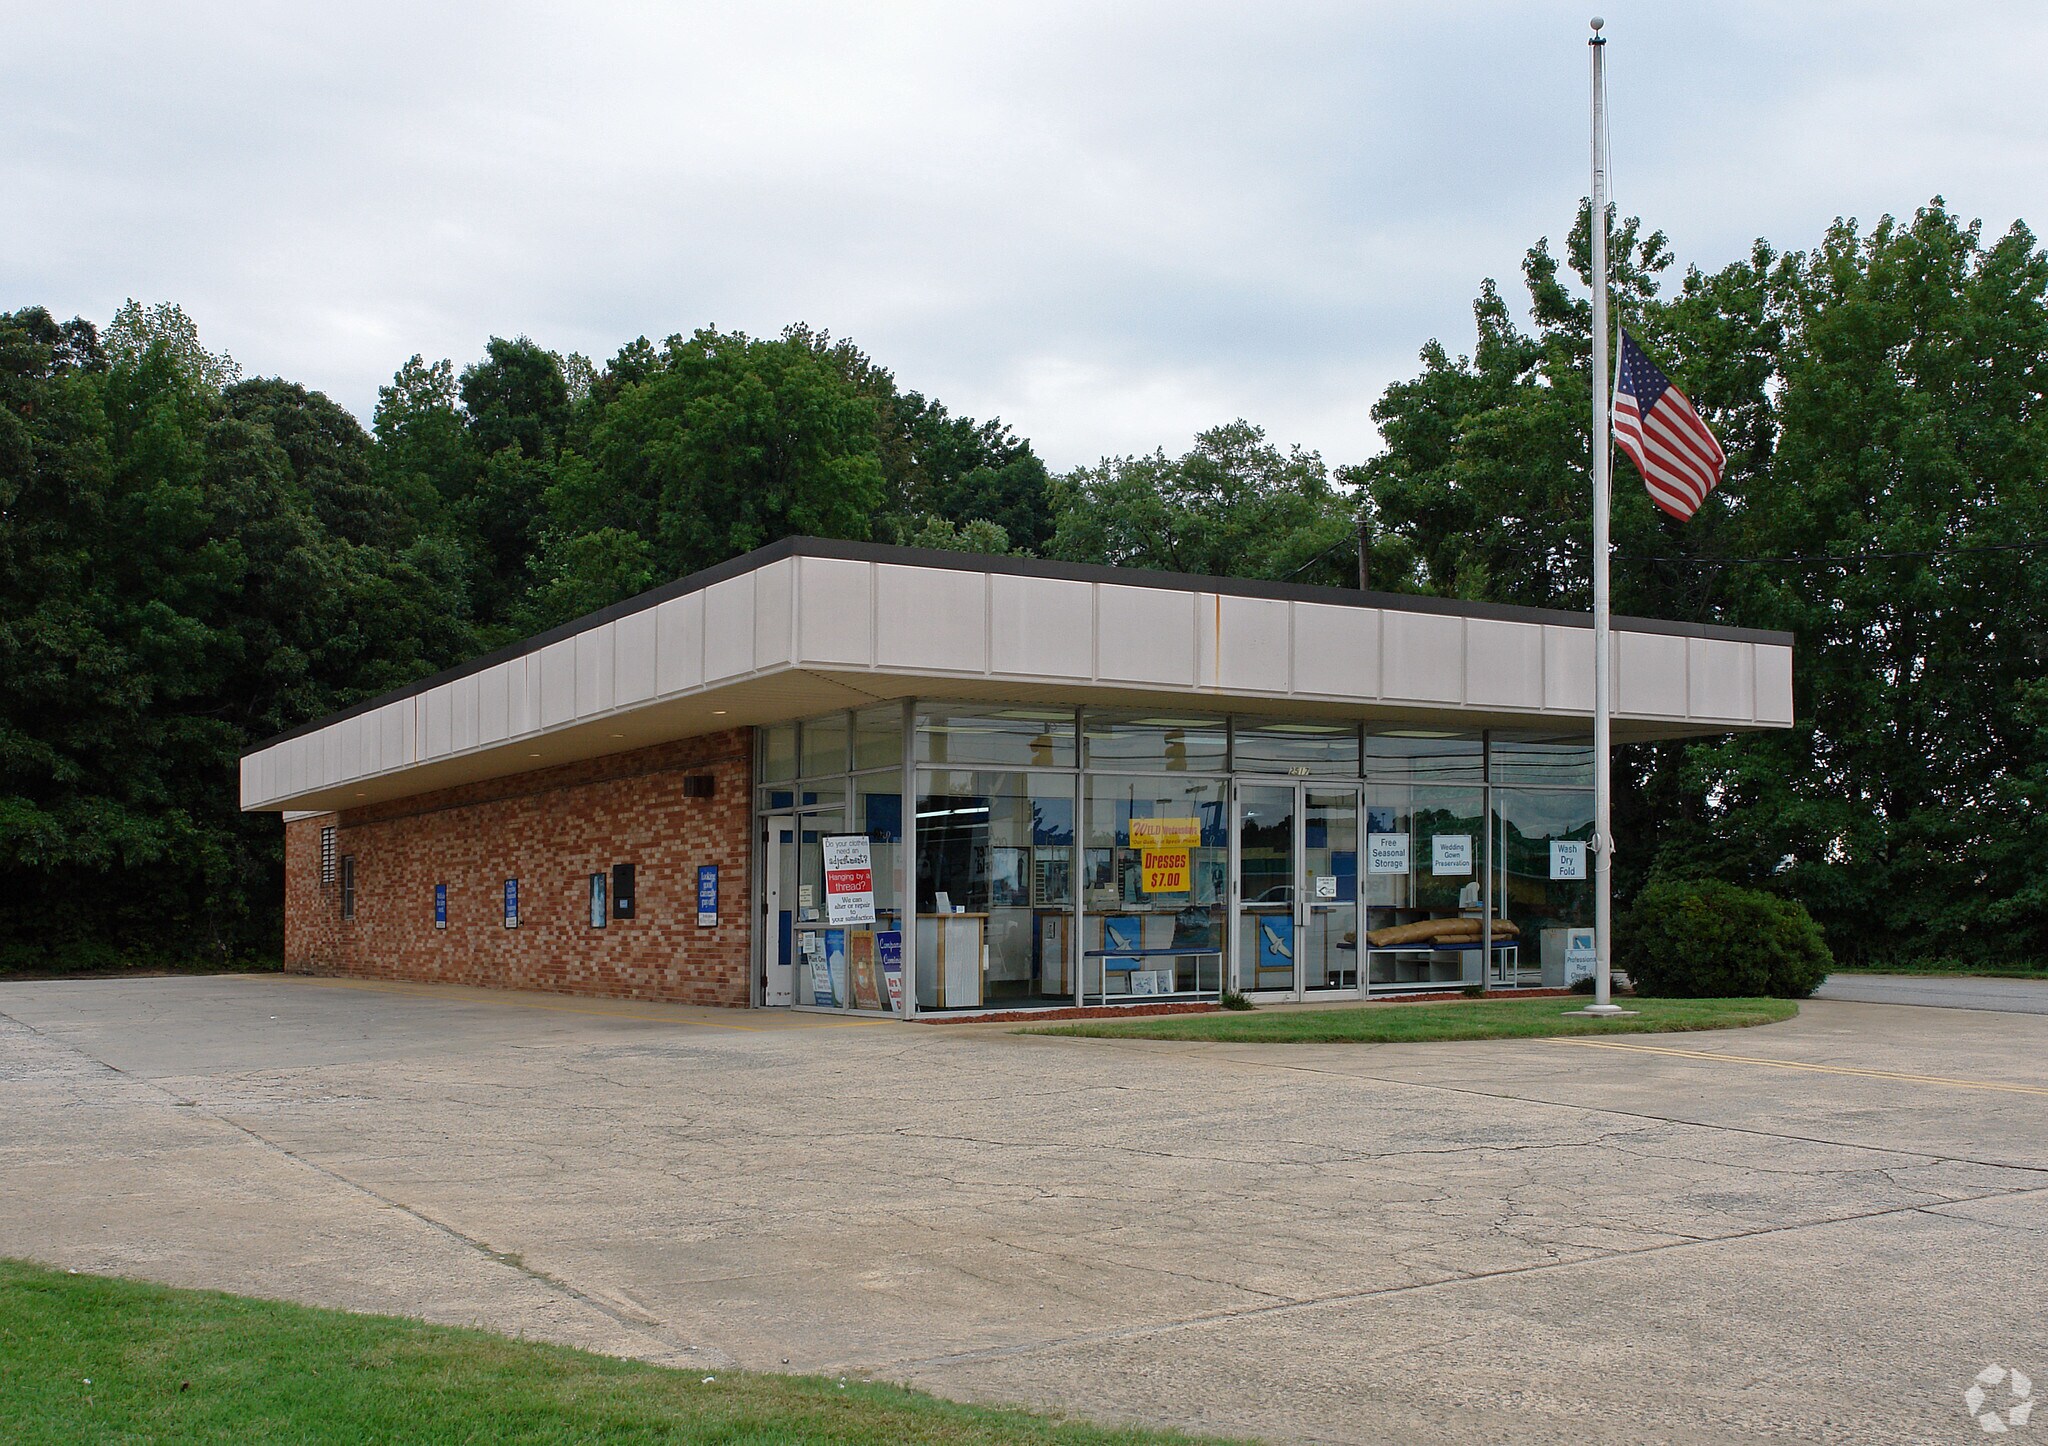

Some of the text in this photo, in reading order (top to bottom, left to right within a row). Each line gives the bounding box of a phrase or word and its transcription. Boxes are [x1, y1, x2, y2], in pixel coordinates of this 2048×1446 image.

[1133, 822, 1161, 836] WILD
[825, 839, 868, 848] Do your clothes
[1380, 838, 1397, 847] Free
[836, 847, 850, 855] need
[1440, 843, 1464, 852] Wedding
[1557, 844, 1578, 853] Wash
[1372, 848, 1406, 857] Seasonal
[1444, 851, 1460, 859] Gown
[829, 855, 868, 869] adjustment?
[1145, 853, 1186, 869] Dresses
[1374, 858, 1403, 869] Storage
[1435, 859, 1470, 867] Preservation
[1560, 855, 1574, 866] Dry
[1559, 866, 1575, 876] Fold
[829, 873, 854, 882] Hanging
[855, 872, 864, 880] by
[1151, 872, 1180, 888] $7.00
[835, 880, 866, 891] thread?
[841, 896, 852, 904] We
[831, 916, 844, 924] your
